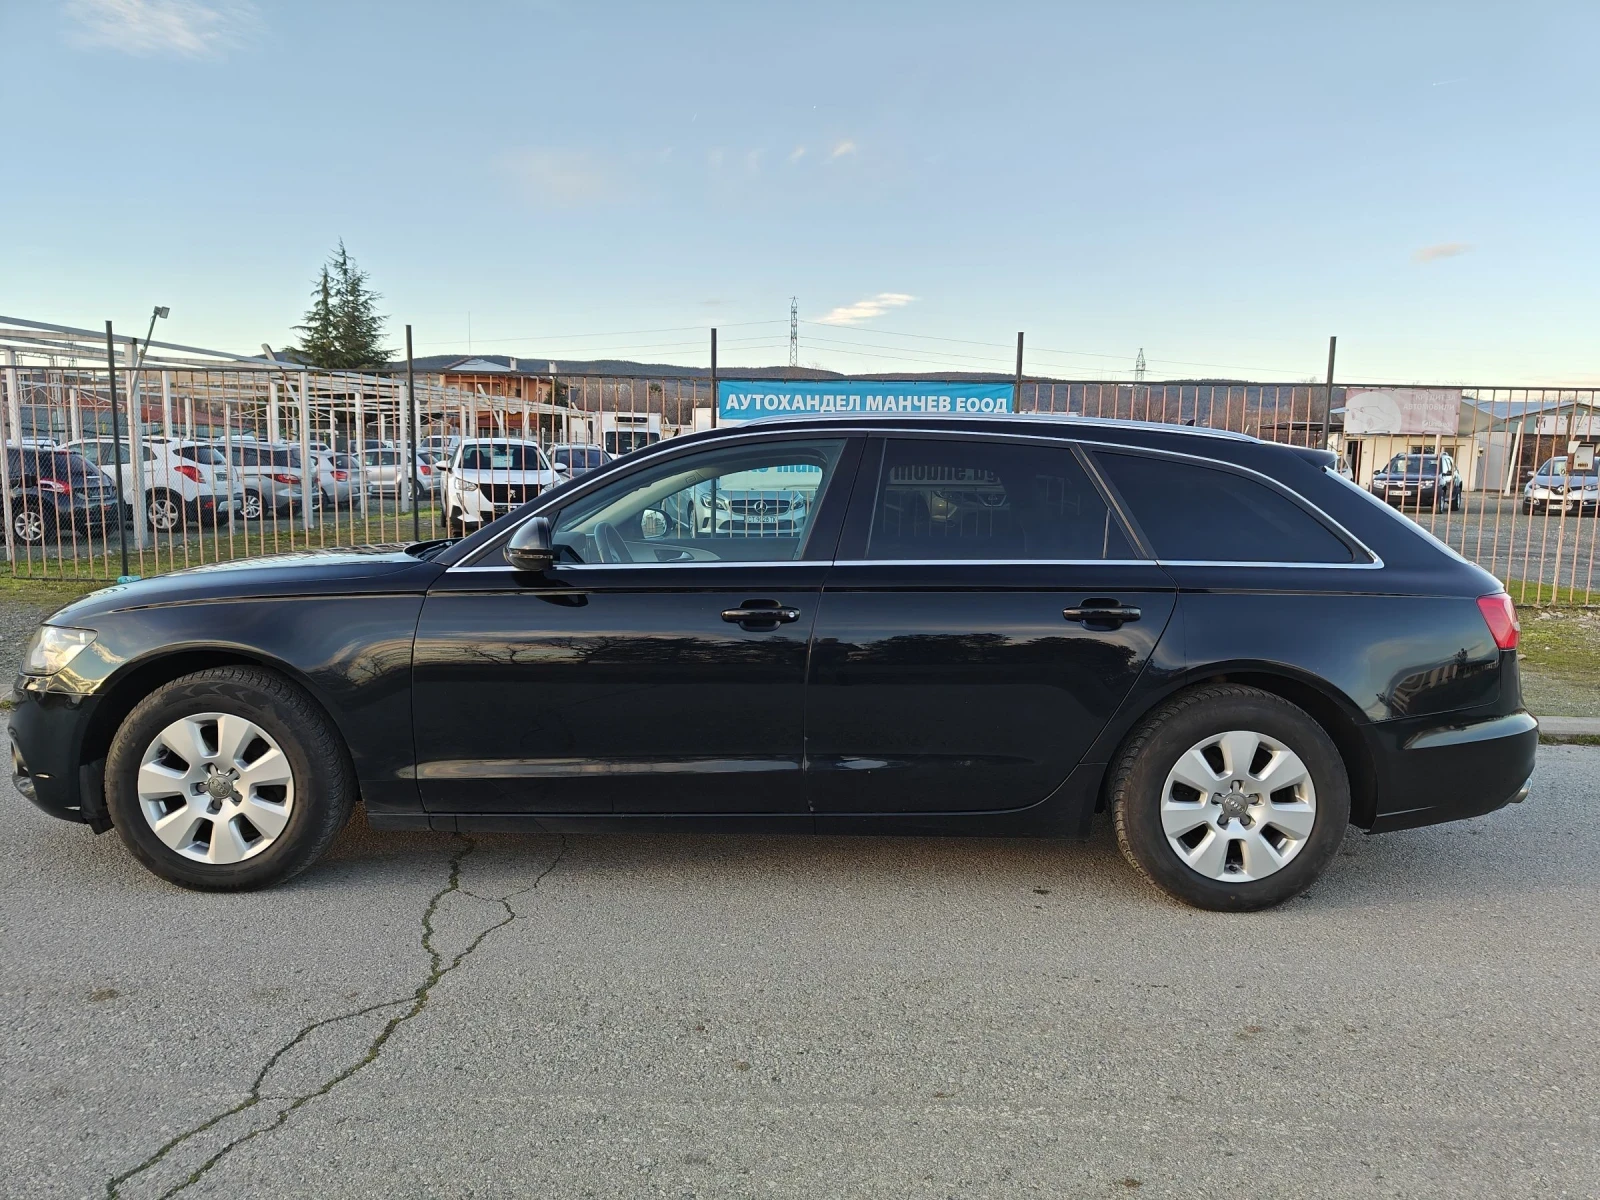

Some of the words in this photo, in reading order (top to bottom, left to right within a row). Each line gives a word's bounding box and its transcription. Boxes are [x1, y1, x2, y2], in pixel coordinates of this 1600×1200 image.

[725, 393, 861, 413] АУТОХАНДЕЛ
[865, 394, 951, 412] МАНЧЕВ
[955, 396, 1008, 414] ЕООД
